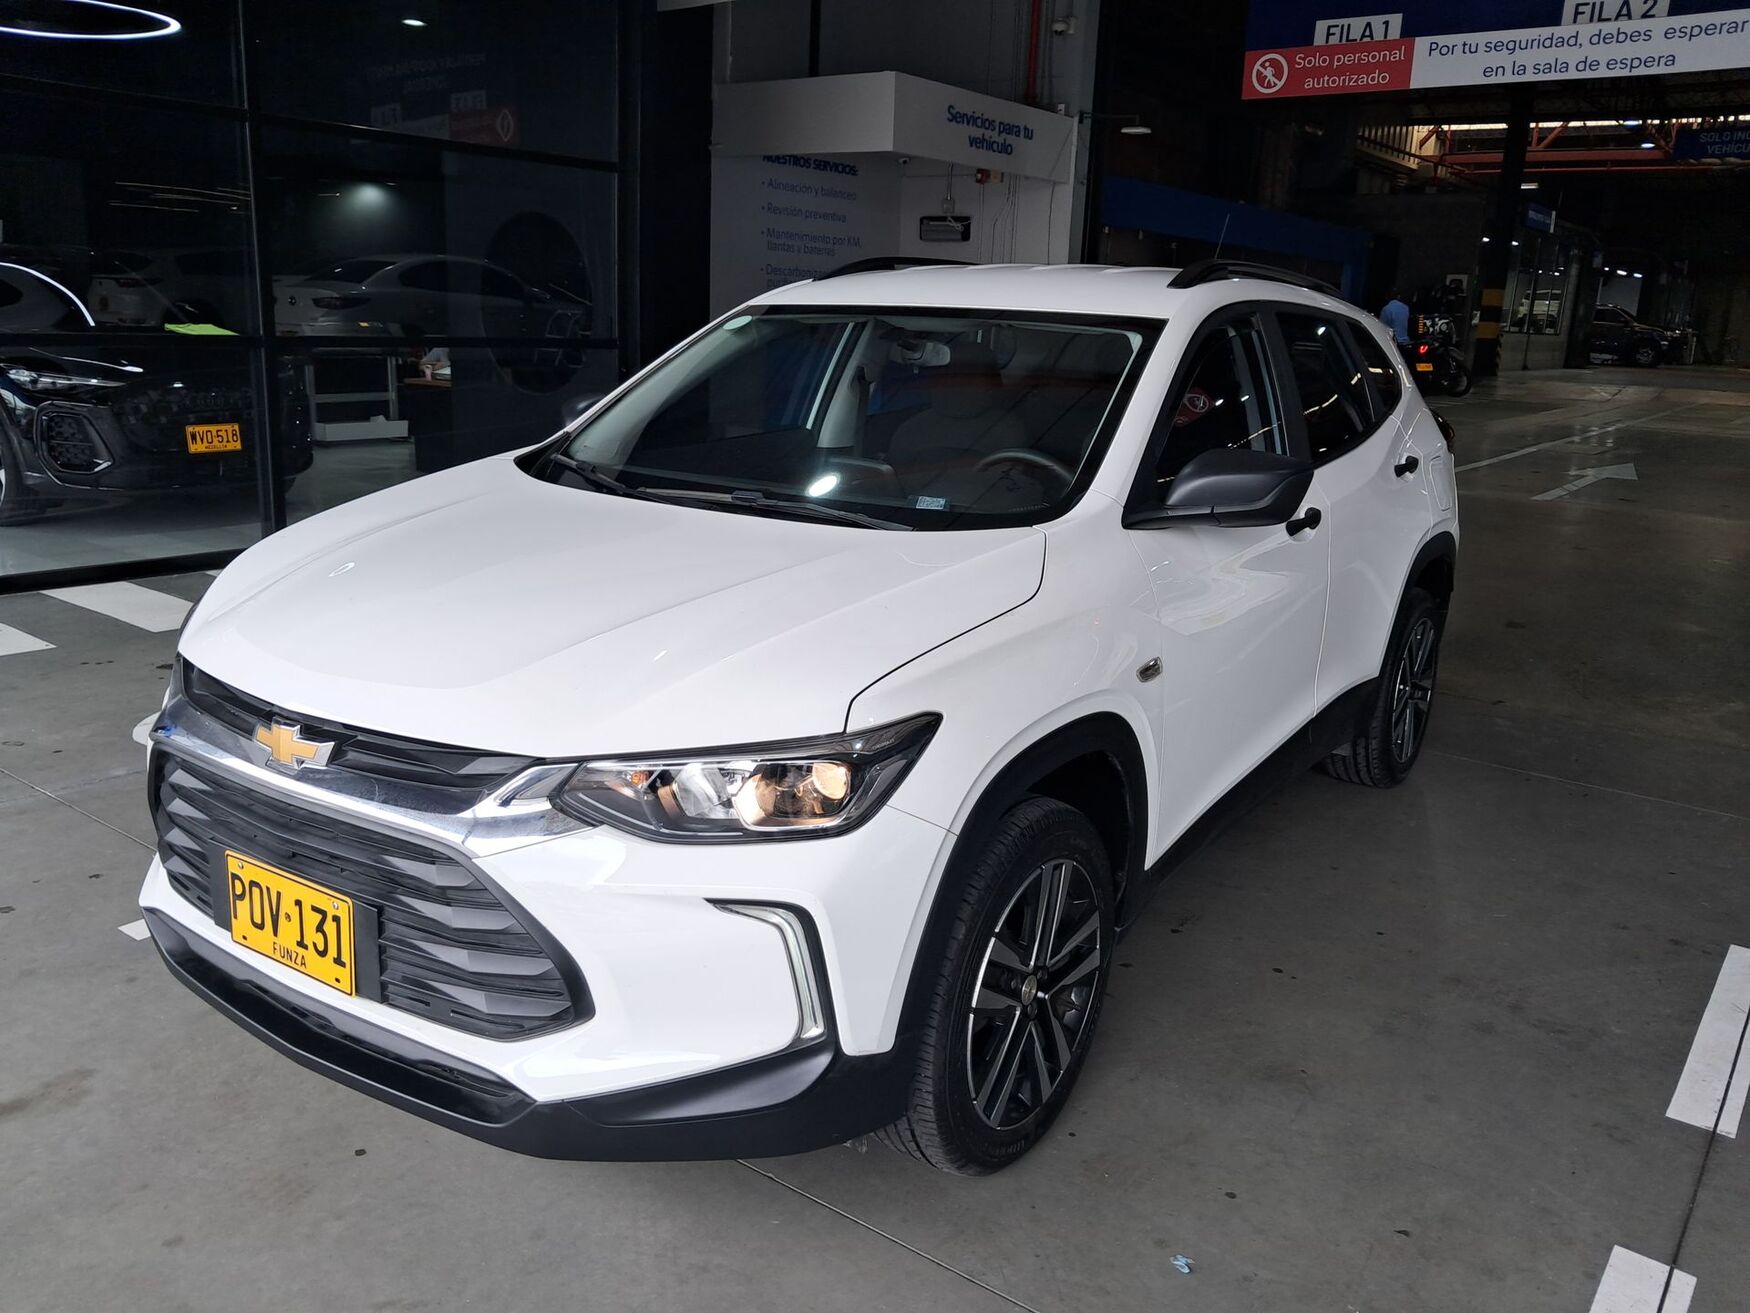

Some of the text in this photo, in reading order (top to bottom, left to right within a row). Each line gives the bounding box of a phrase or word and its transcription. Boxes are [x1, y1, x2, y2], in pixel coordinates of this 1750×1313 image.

[1573, 0, 1658, 24] FILA 2
[1325, 20, 1390, 44] FILA 1
[1428, 18, 1750, 57] Por tu seguridad, debes esperar
[1295, 45, 1406, 69] Solo personal
[1482, 54, 1677, 78] en la sala de espera
[1304, 69, 1391, 89] autorizado
[947, 104, 1034, 140] Servicios para tu
[1700, 131, 1731, 142] SOLO
[272, 941, 307, 969] FUNZA
